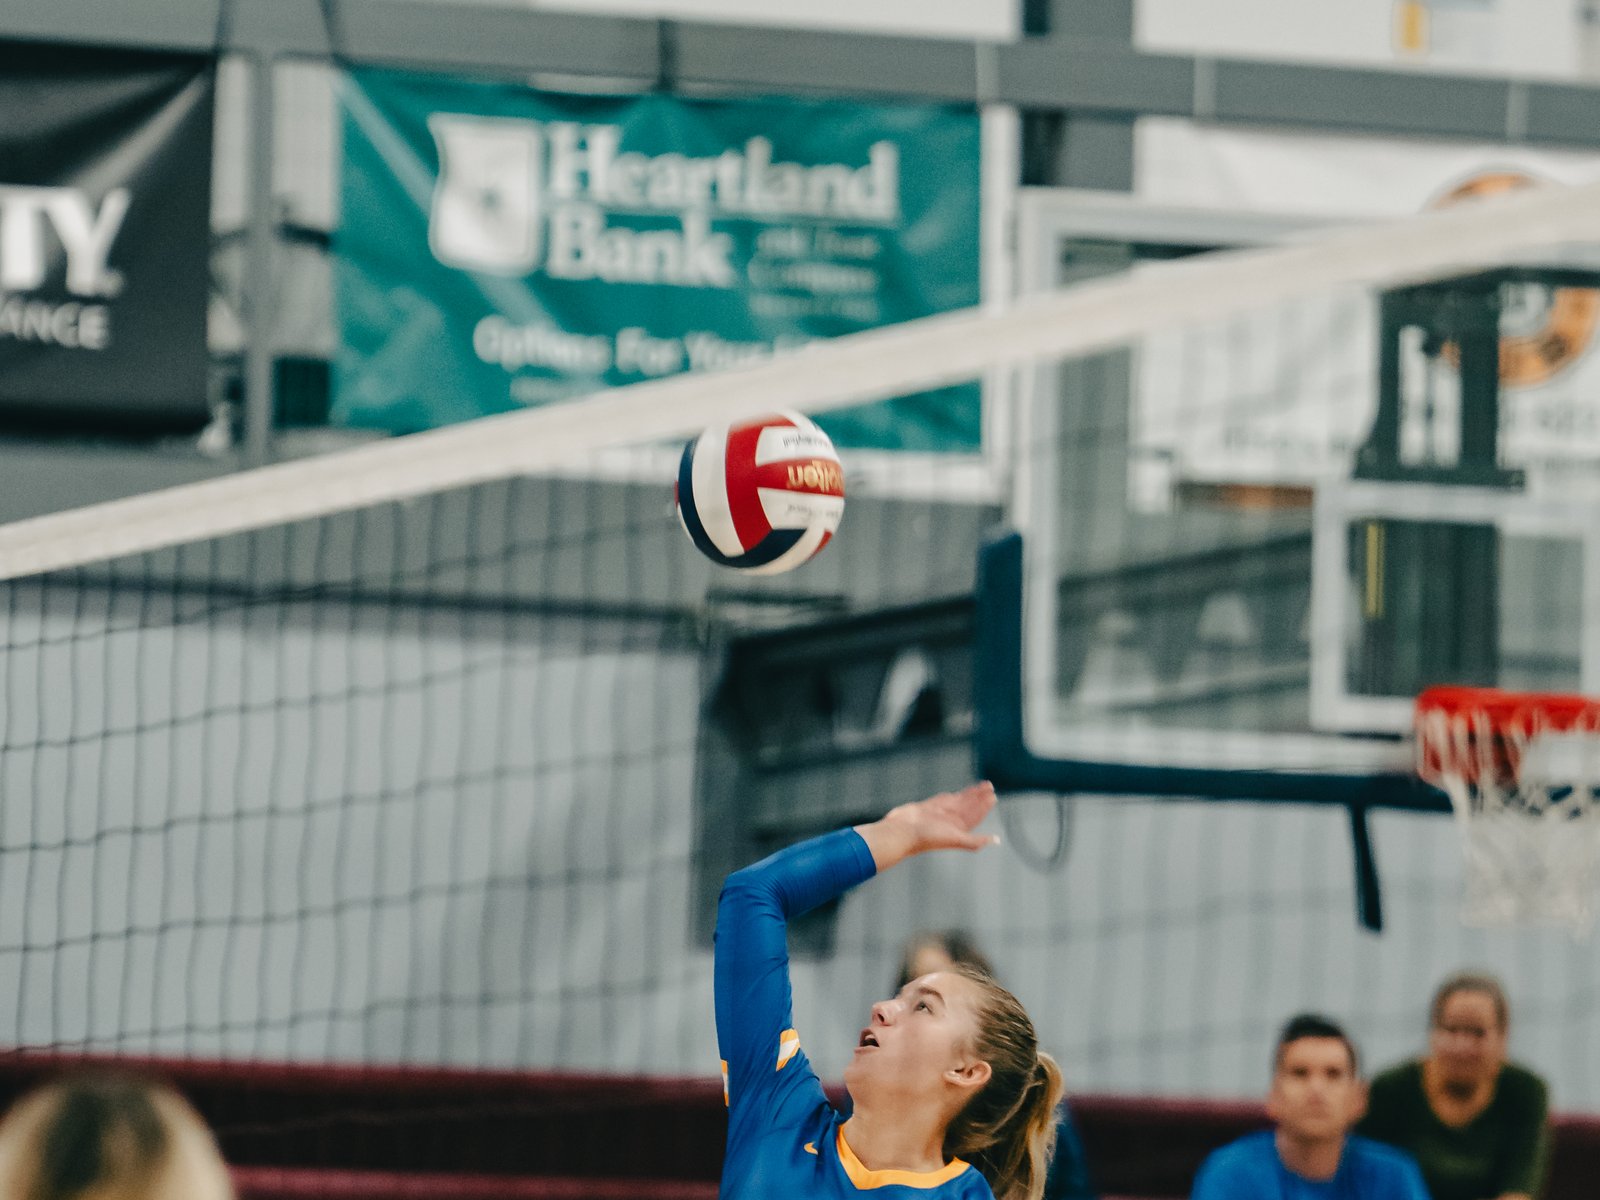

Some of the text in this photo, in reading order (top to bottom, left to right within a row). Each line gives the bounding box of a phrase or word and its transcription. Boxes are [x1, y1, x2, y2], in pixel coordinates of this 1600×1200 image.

[549, 121, 898, 222] Heartland
[547, 205, 736, 289] Bank
[616, 327, 685, 376] For
